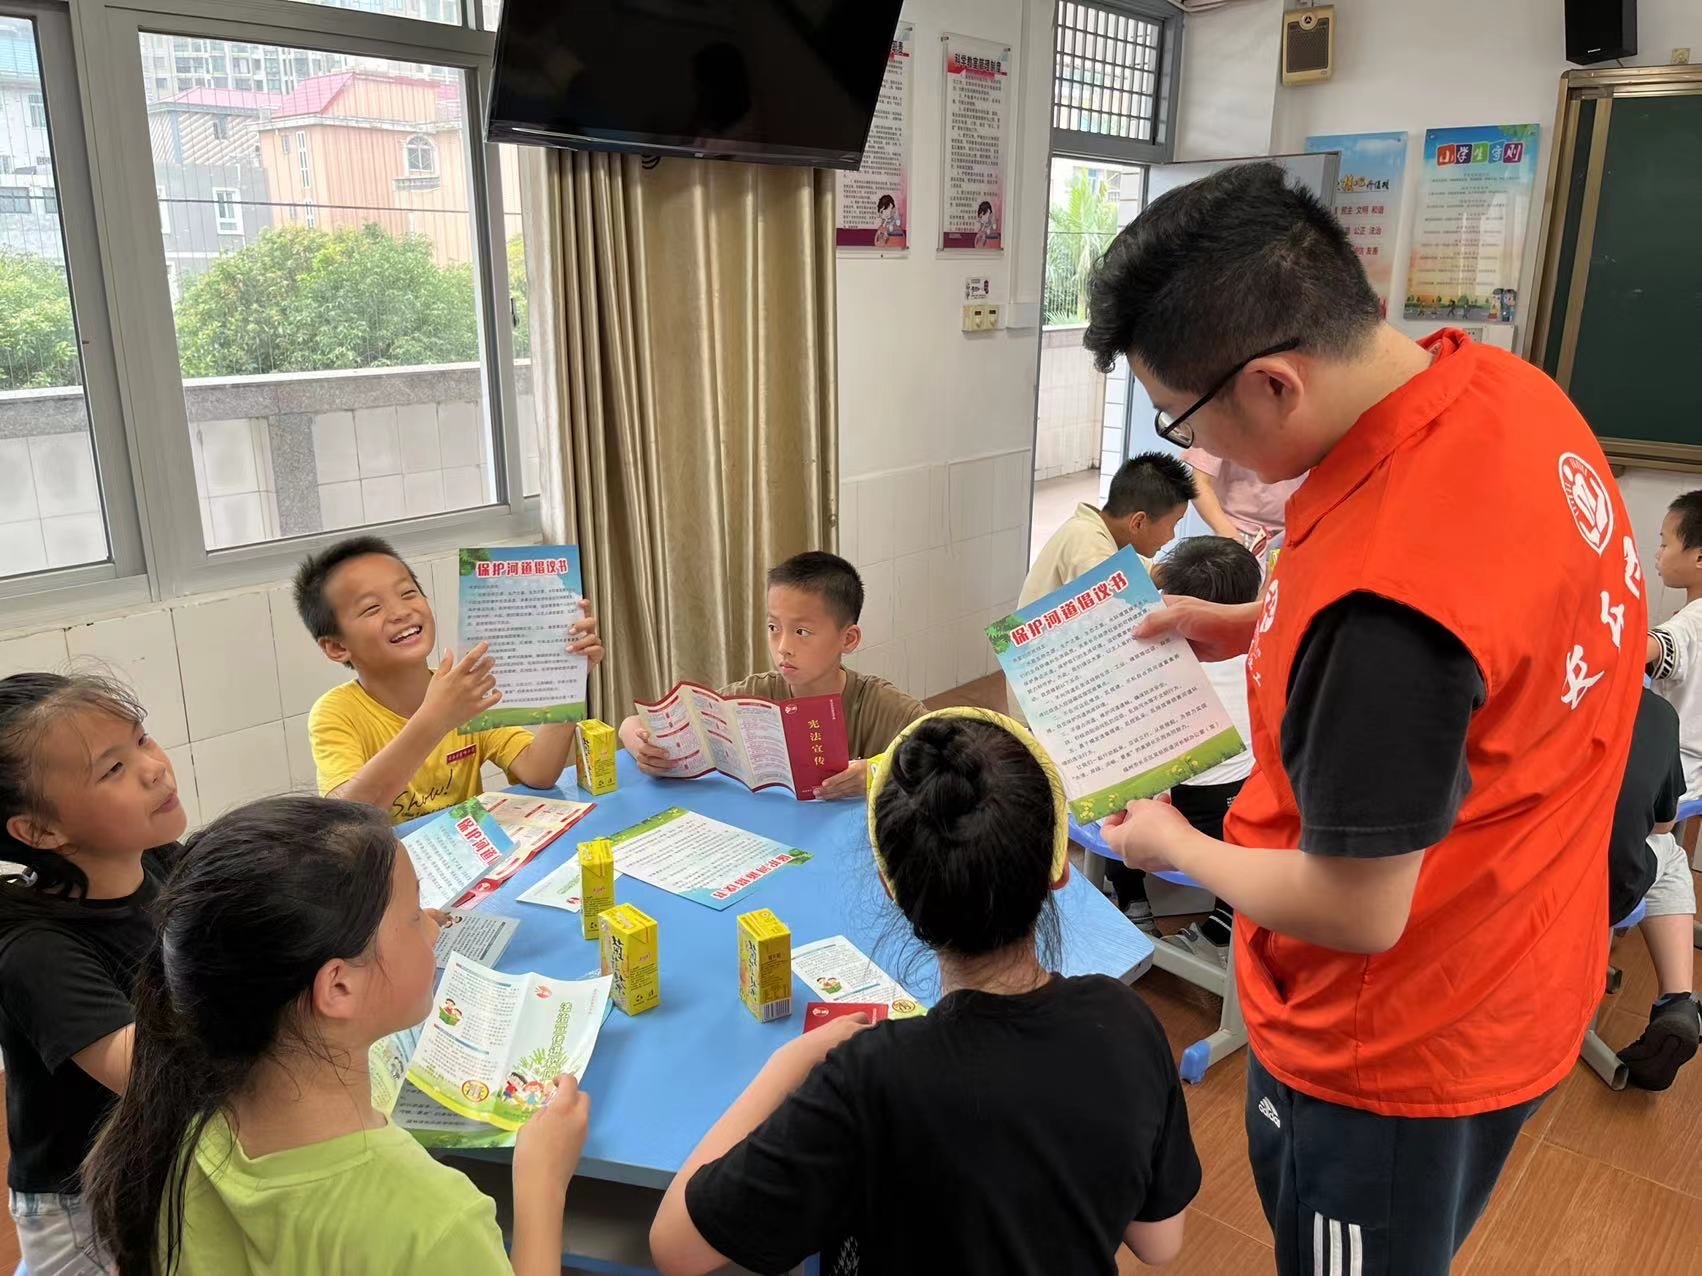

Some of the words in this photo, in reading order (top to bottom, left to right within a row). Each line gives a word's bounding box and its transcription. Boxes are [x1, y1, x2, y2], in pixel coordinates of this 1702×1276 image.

[1437, 142, 1523, 166] 小学生守则
[476, 559, 569, 578] 保护河道倡议书
[1011, 572, 1129, 646] 保护河道倡议书
[808, 719, 825, 766] 宪法宣传
[392, 769, 453, 817] Show!
[457, 817, 500, 866] 保护河道
[713, 854, 792, 899] 保护河道倡议书
